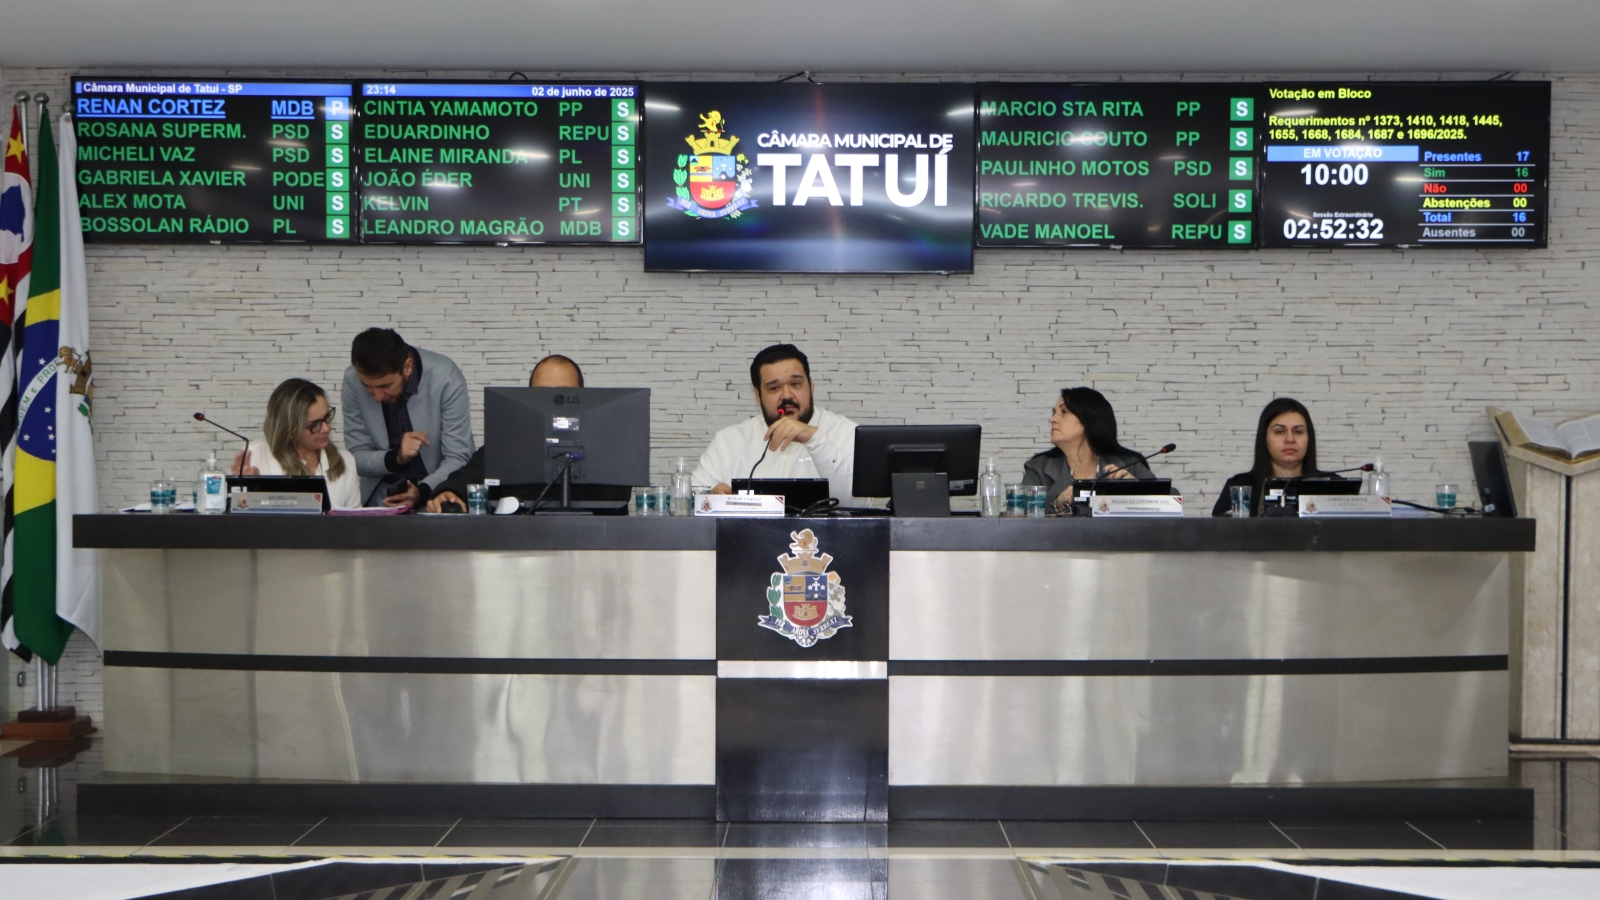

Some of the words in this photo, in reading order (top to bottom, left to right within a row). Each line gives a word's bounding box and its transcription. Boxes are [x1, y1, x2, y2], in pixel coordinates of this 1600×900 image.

[83, 83, 123, 93] Câmara
[126, 83, 176, 94] Municipal
[178, 84, 191, 93] de
[194, 84, 219, 93] Tatuí
[228, 85, 242, 93] SP
[366, 85, 396, 94] 23:14
[532, 88, 544, 96] 02
[547, 88, 560, 96] de
[562, 88, 592, 98] junho
[594, 88, 607, 96] de
[609, 88, 634, 96] 2025
[1270, 88, 1314, 100] Votação
[1317, 90, 1336, 99] em
[1338, 88, 1371, 99] Bloco
[77, 99, 142, 114] RENAN
[148, 100, 225, 115] CORTEZ
[271, 101, 315, 115] MDB
[331, 101, 344, 115] P
[364, 100, 425, 115] CINTIA
[430, 101, 538, 116] YAMAMOTO
[559, 102, 582, 116] PP
[617, 102, 629, 117] S
[982, 102, 1056, 116] MARCIO
[1063, 102, 1097, 116] STA
[1103, 102, 1143, 116] RITA
[1176, 102, 1201, 116] PP
[1236, 102, 1248, 116] S
[1269, 116, 1355, 127] Requerimentos
[1359, 116, 1371, 126] nº
[1373, 116, 1403, 127] 1373,
[1406, 116, 1436, 127] 1410,
[1439, 116, 1469, 127] 1418,
[1473, 116, 1502, 127] 1445,
[78, 123, 157, 137] ROSANA
[162, 123, 246, 138] SUPERM.
[273, 124, 309, 139] PSD
[331, 124, 343, 139] S
[365, 125, 489, 140] EDUARDINHO
[559, 126, 609, 140] REPU
[617, 126, 629, 141] S
[757, 130, 832, 147] CÂMARA
[835, 134, 927, 147] MUNICIPAL
[929, 134, 953, 147] DE
[981, 131, 1075, 146] MAURICIO
[1080, 131, 1147, 146] COUTO
[1176, 132, 1200, 146] PP
[1236, 132, 1247, 146] S
[1269, 129, 1299, 141] 1655,
[1303, 129, 1332, 141] 1668,
[1335, 129, 1365, 141] 1684,
[1368, 129, 1394, 139] 1687
[1407, 129, 1467, 139] 1696/2025.
[78, 147, 154, 161] MICHELI
[160, 147, 195, 161] VAZ
[273, 148, 309, 162] PSD
[331, 148, 343, 163] S
[365, 149, 433, 163] ELAINE
[440, 149, 528, 163] MIRANDA
[559, 150, 582, 164] PL
[617, 150, 629, 164] S
[1303, 148, 1322, 158] EM
[1325, 146, 1382, 160] VOTAÇÃO
[1424, 151, 1482, 162] Presentes
[1516, 152, 1529, 161] 17
[981, 160, 1075, 175] PAULINHO
[1082, 161, 1149, 175] MOTOS
[1174, 161, 1211, 175] PSD
[1235, 161, 1247, 176] S
[1301, 164, 1369, 185] 10:00
[1424, 168, 1445, 177] Sim
[1516, 168, 1529, 177] 16
[79, 170, 174, 185] GABRIELA
[180, 171, 246, 186] XAVIER
[273, 172, 324, 186] PODE
[331, 172, 343, 186] S
[364, 169, 415, 187] JOÃO
[422, 169, 472, 187] ÉDER
[559, 174, 590, 188] UNI
[617, 174, 629, 188] S
[757, 146, 949, 206] TATUÍ
[1424, 182, 1447, 193] Não
[1513, 184, 1527, 193] 00
[80, 194, 127, 208] ALEX
[134, 194, 186, 209] MOTA
[273, 196, 304, 210] UNI
[331, 196, 343, 210] S
[364, 197, 428, 211] KELVIN
[559, 198, 582, 212] PT
[617, 198, 629, 212] S
[981, 193, 1066, 207] RICARDO
[1073, 193, 1143, 208] TREVIS.
[1173, 194, 1216, 208] SOLI
[1234, 194, 1246, 208] S
[1423, 197, 1490, 209] Abstenções
[1513, 198, 1527, 208] 00
[82, 217, 183, 232] BOSSOLAN
[190, 215, 249, 233] RÁDIO
[273, 219, 296, 233] PL
[331, 219, 343, 234] S
[1424, 212, 1451, 223] Total
[1513, 213, 1526, 222] 16
[364, 220, 454, 235] LEANDRO
[460, 217, 544, 235] MAGRÃO
[560, 221, 601, 235] MDB
[617, 221, 629, 236] S
[980, 224, 1029, 239] VADE
[1035, 224, 1115, 239] MANOEL
[1172, 225, 1222, 239] REPU
[1233, 225, 1245, 239] S
[1283, 219, 1383, 240] 02:52:32
[1423, 227, 1476, 238] Ausentes
[1512, 228, 1525, 237] 00
[567, 395, 580, 404] LG
[775, 618, 785, 627] PER
